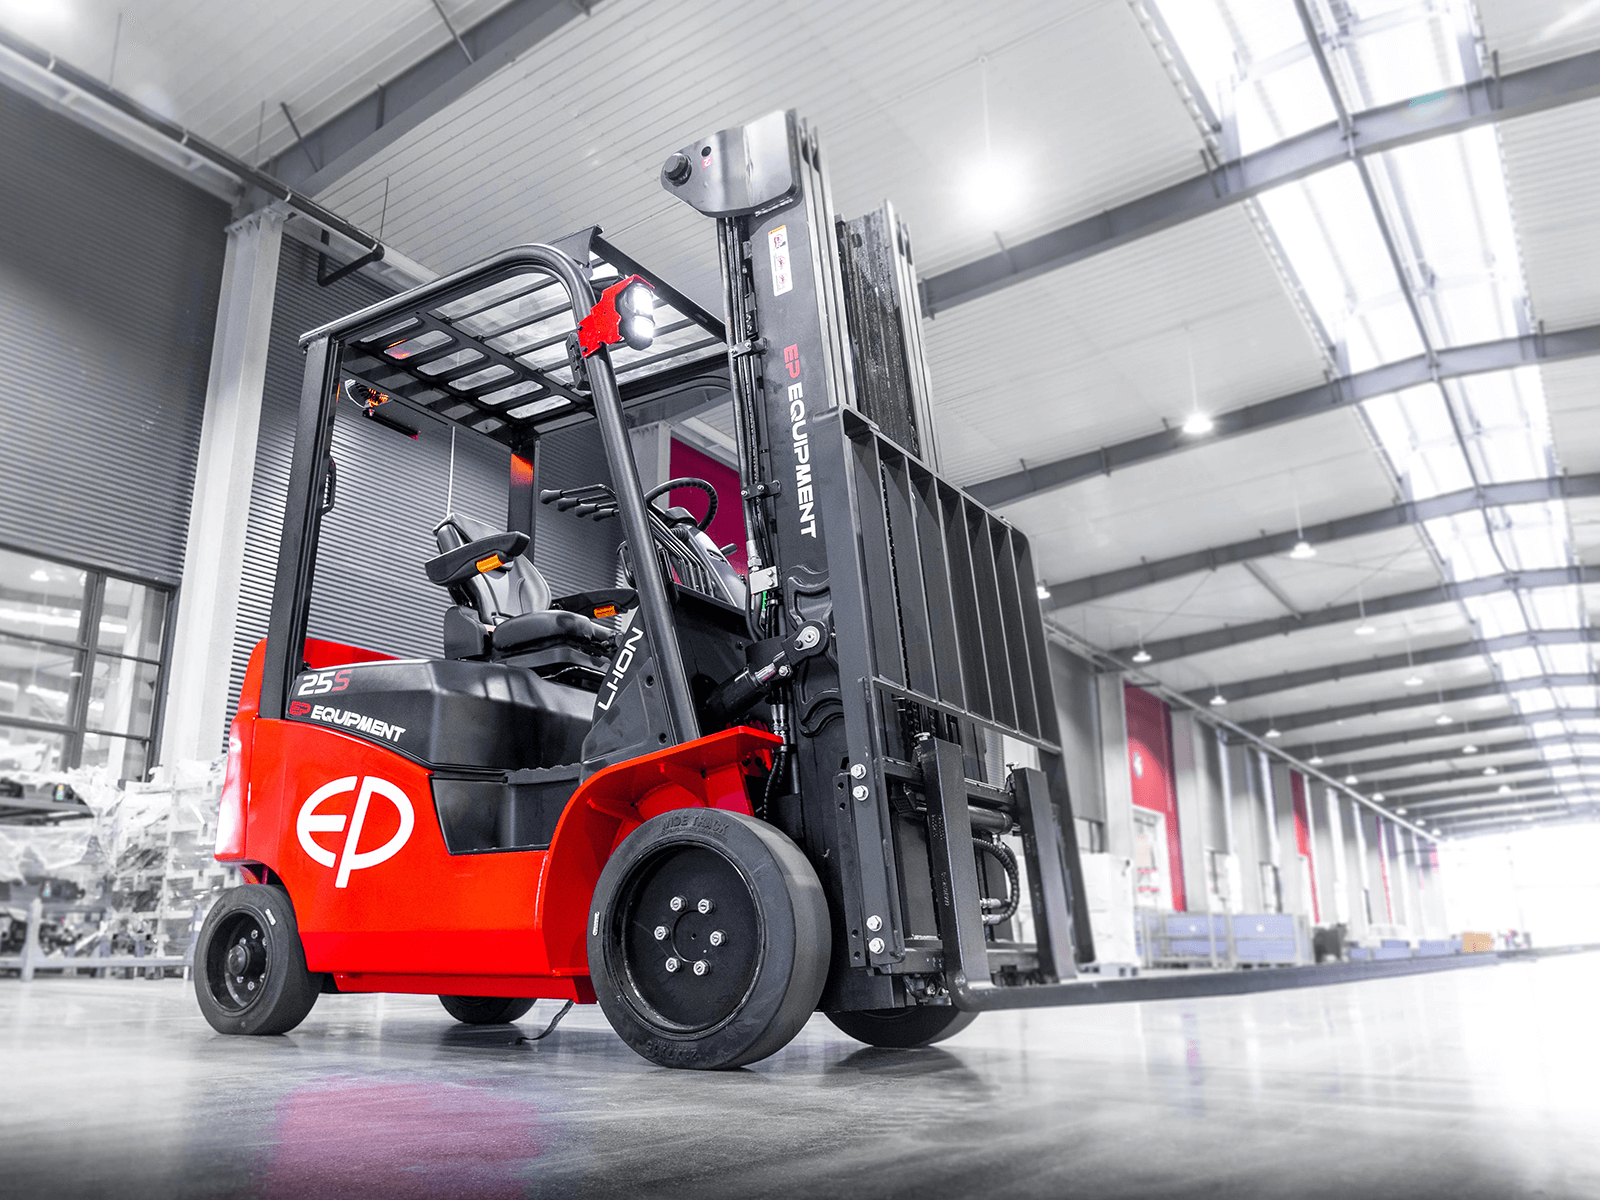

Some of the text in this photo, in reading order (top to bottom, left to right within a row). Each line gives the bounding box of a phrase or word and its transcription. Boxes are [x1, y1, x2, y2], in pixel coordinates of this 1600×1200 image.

[783, 343, 817, 539] EP EQUIPMENT
[297, 669, 353, 696] 25S
[597, 626, 644, 711] LI-ION
[289, 700, 407, 742] EP EQUIPMENT
[296, 775, 415, 889] EP
[662, 815, 689, 830] WIDE
[692, 815, 730, 836] TRACK
